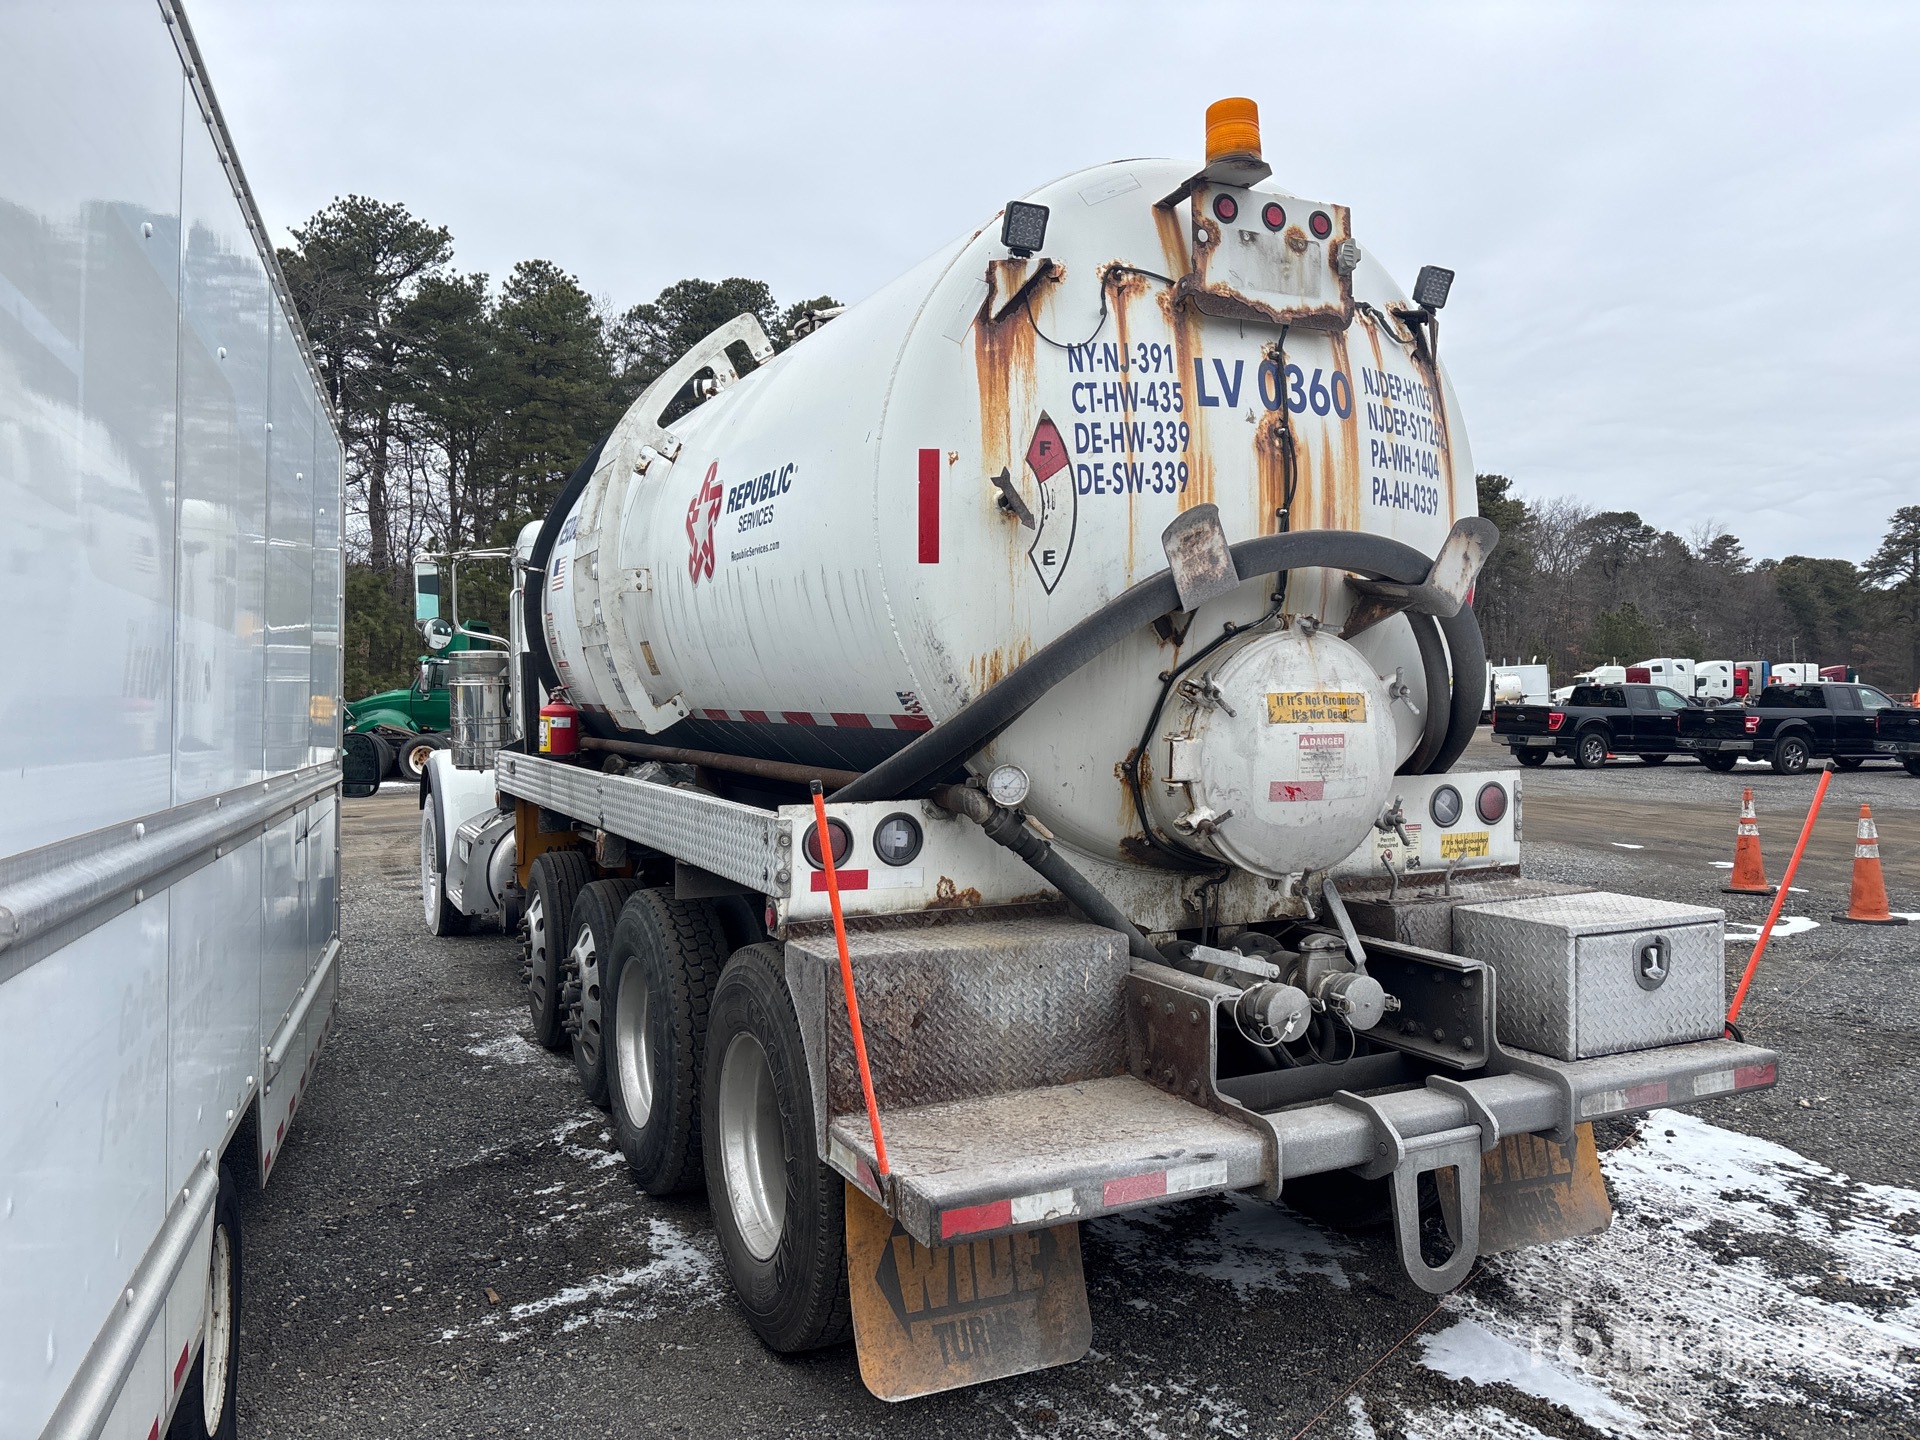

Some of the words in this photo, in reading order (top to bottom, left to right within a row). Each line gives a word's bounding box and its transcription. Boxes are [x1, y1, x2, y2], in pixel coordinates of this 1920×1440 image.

[1068, 342, 1174, 374] NY-NJ-391
[1072, 380, 1183, 414] CT-HW-435
[1194, 357, 1245, 409] LV
[1258, 359, 1353, 420] 0360
[1039, 441, 1052, 456] F
[1075, 420, 1189, 455] DE-HW-339
[1371, 439, 1439, 481] PA-WH-1404
[726, 462, 794, 515] REPUBLIC
[1077, 461, 1188, 496] DE-SW-339
[1372, 476, 1438, 516] PA-AH-0339
[738, 504, 775, 534] SERVICES
[731, 541, 780, 563] RepublicServices.com
[1043, 550, 1056, 566] E
[1305, 695, 1320, 706] Not
[1322, 694, 1360, 706] Grounded
[1309, 709, 1325, 719] Not
[1309, 737, 1344, 746] DANGER
